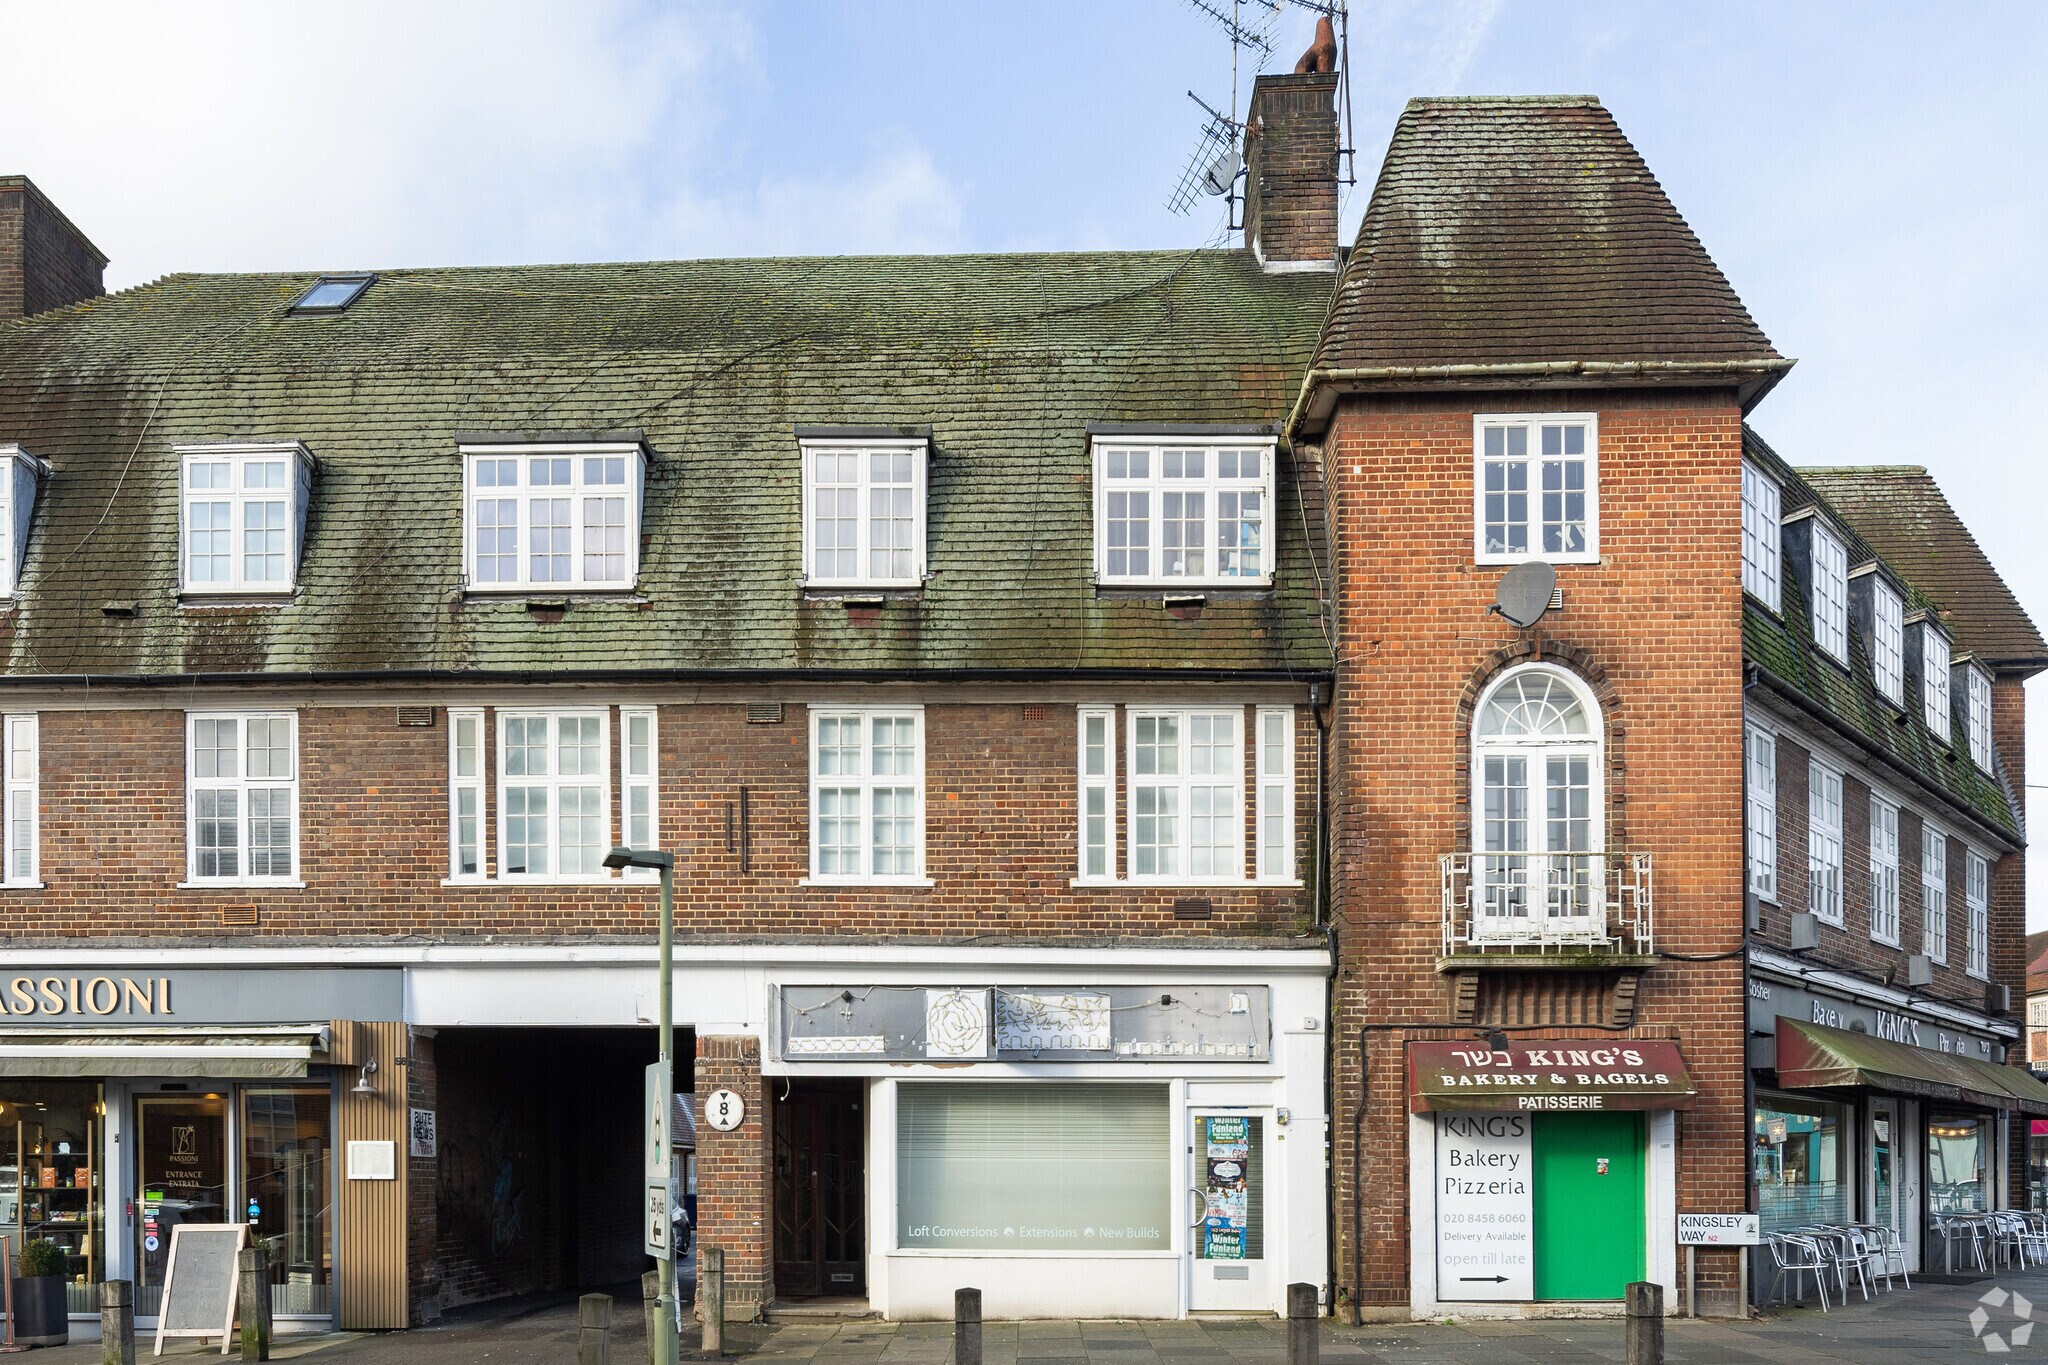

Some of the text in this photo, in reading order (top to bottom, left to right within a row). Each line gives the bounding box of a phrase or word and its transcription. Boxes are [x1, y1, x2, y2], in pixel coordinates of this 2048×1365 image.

[0, 977, 172, 1015] SSIONI
[1452, 1050, 1512, 1067] כשר
[1525, 1047, 1644, 1067] KING'S
[1441, 1072, 1670, 1086] BAKERY & BAGELS
[1518, 1096, 1602, 1110] PATISSERIE
[1211, 1123, 1244, 1133] Funland
[1450, 1149, 1520, 1171] Bakery
[165, 1170, 203, 1179] ENTRANCE
[168, 1180, 200, 1188] ENTRATA
[1445, 1177, 1525, 1195] Pizzeria
[1444, 1213, 1526, 1223] 020 8458 6060
[1680, 1216, 1742, 1228] KINGSLEY
[908, 1225, 1160, 1239] Loft Conversions Extensions New Builds
[1211, 1232, 1240, 1245] Winter
[1444, 1232, 1526, 1242] Delivery Available
[1680, 1231, 1706, 1242] WAY
[1209, 1242, 1242, 1254] Funland
[1444, 1252, 1526, 1267] open till late
